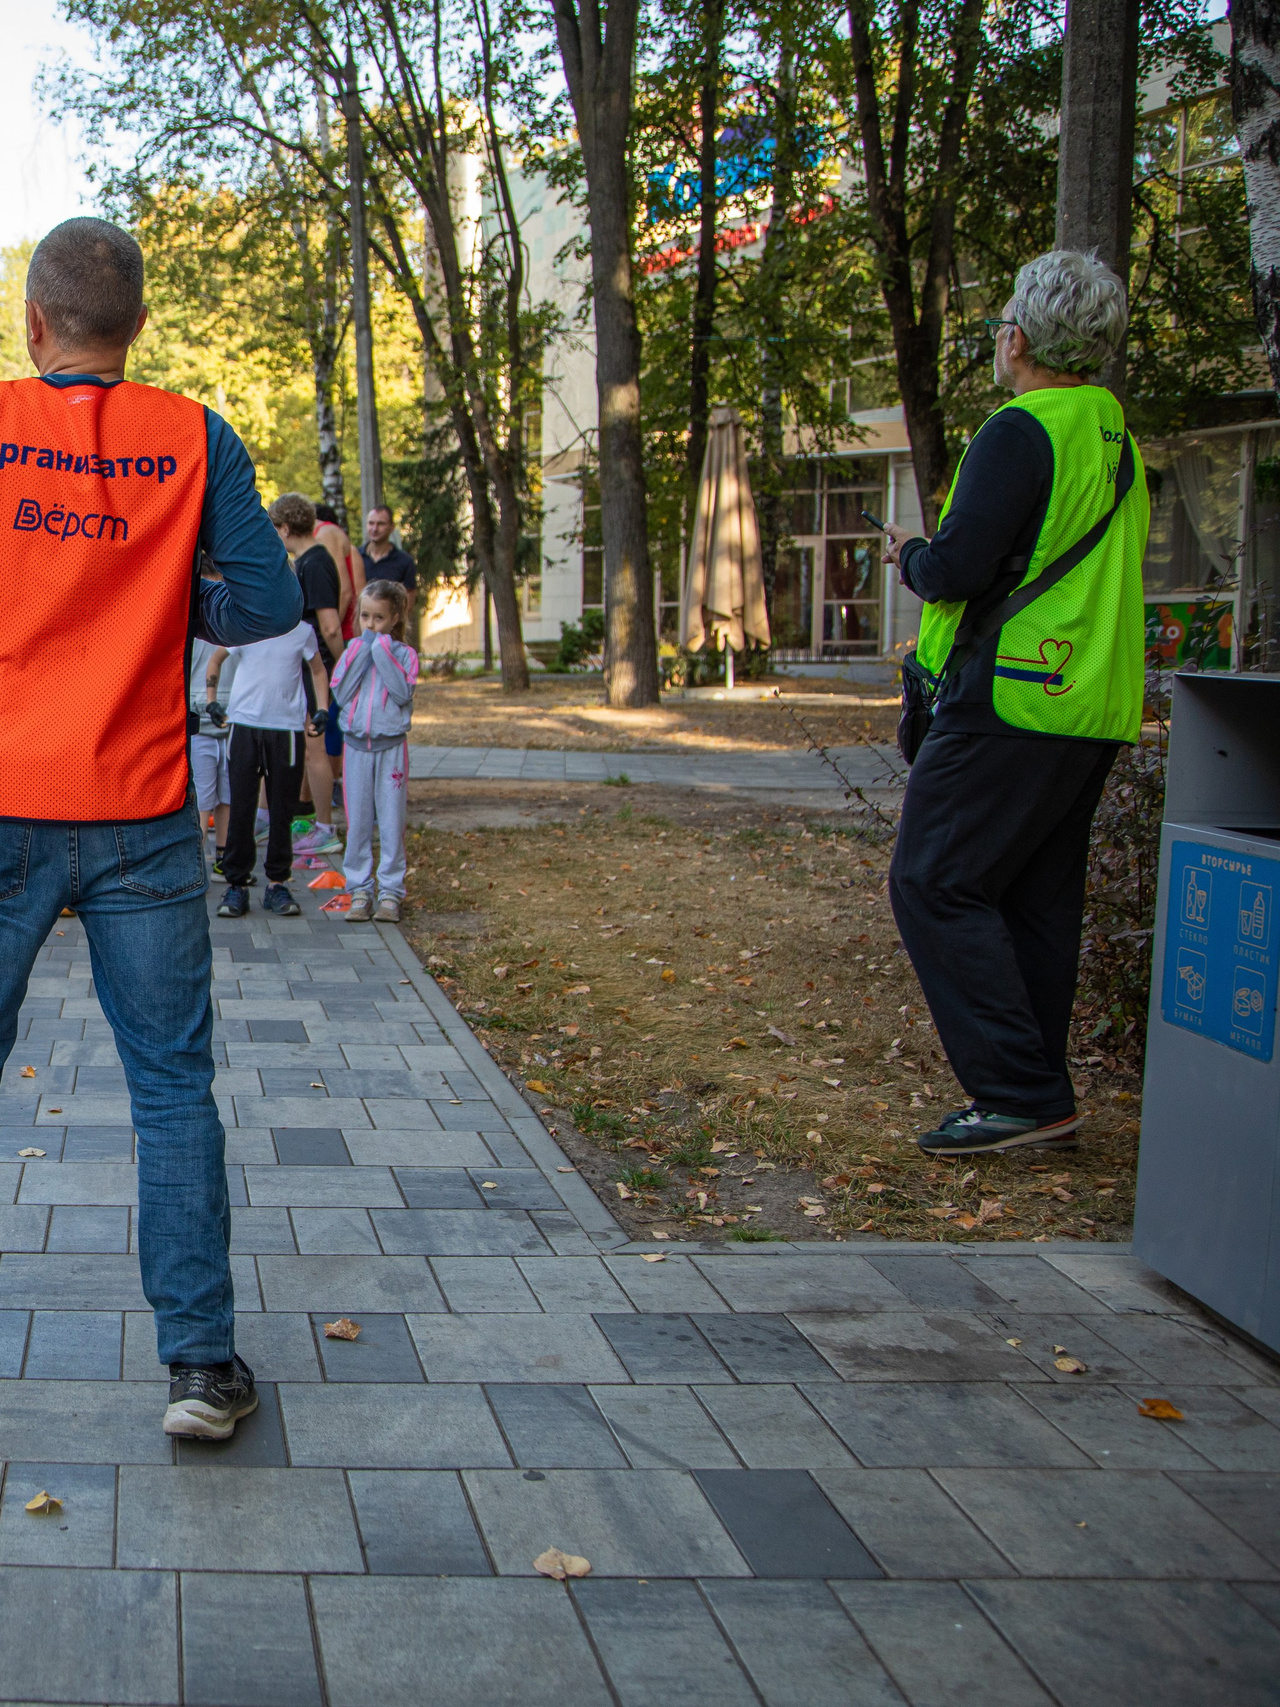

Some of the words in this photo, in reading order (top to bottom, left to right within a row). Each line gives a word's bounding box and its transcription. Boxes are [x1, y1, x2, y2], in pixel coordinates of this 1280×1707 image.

[1201, 853, 1252, 876] ВТОРСЫРЬЕ
[1179, 928, 1208, 946] СТЕКЛО
[1233, 944, 1270, 965] ПЛАСТИК
[1173, 1008, 1202, 1026] БУМАГА
[1230, 1031, 1262, 1050] МЕТАЛЛ
